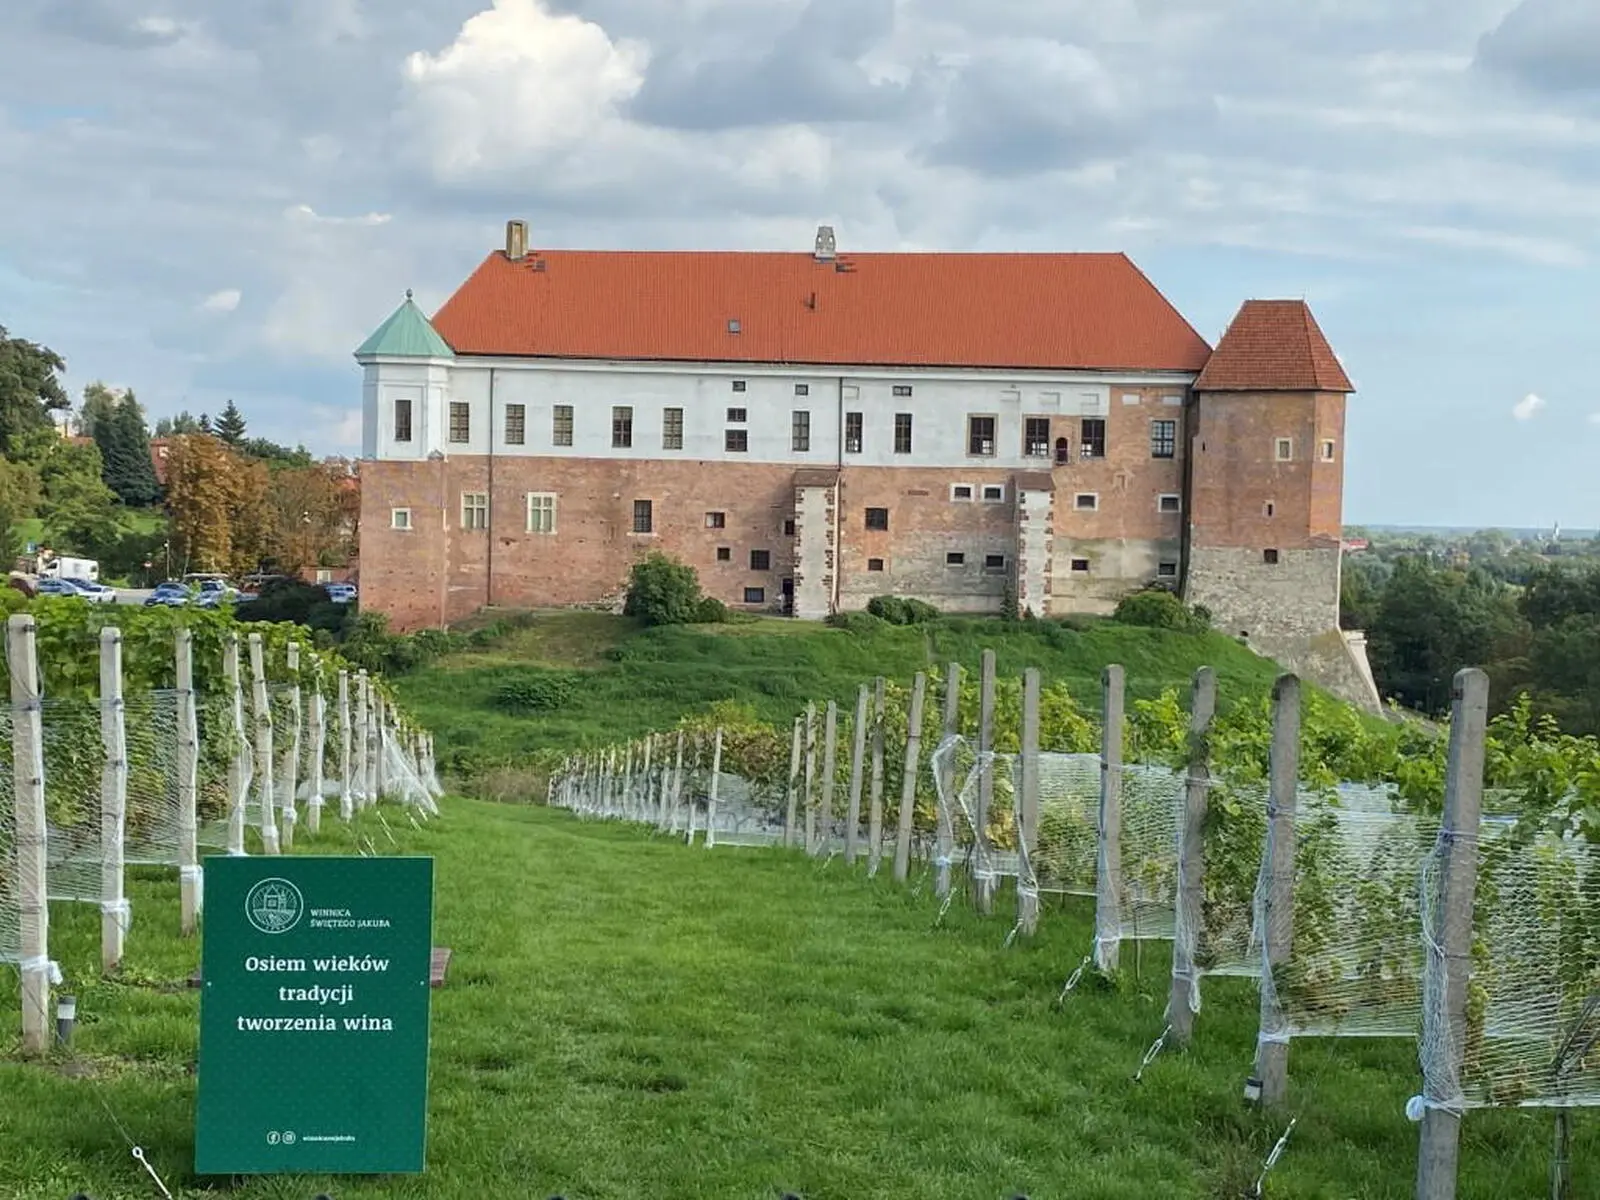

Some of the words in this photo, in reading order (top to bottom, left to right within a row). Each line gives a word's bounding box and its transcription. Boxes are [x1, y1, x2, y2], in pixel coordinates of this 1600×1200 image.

[310, 909, 351, 917] WINNICA
[245, 955, 306, 971] Osiem
[313, 954, 389, 971] wieków
[279, 984, 354, 1005] tradycji
[237, 1014, 336, 1031] tworzenia
[343, 1014, 393, 1031] wina
